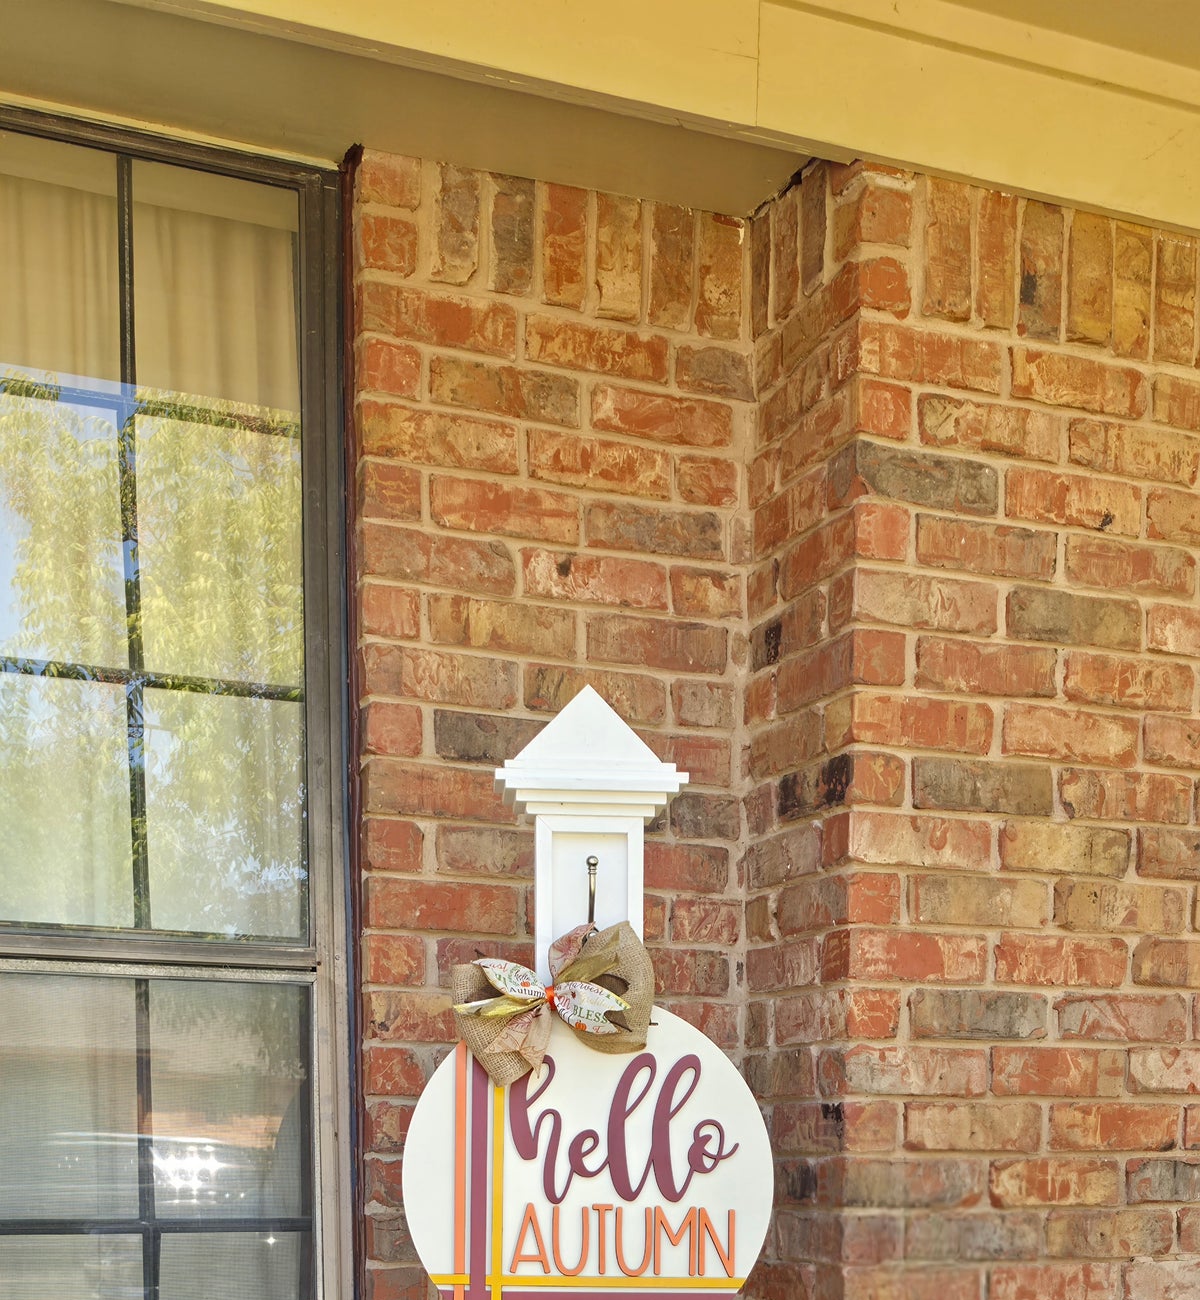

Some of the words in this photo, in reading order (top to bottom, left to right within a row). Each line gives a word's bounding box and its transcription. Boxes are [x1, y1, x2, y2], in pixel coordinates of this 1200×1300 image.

[509, 986, 546, 999] Autumn
[509, 1053, 739, 1204] hello
[509, 1202, 736, 1278] AUTUMN
